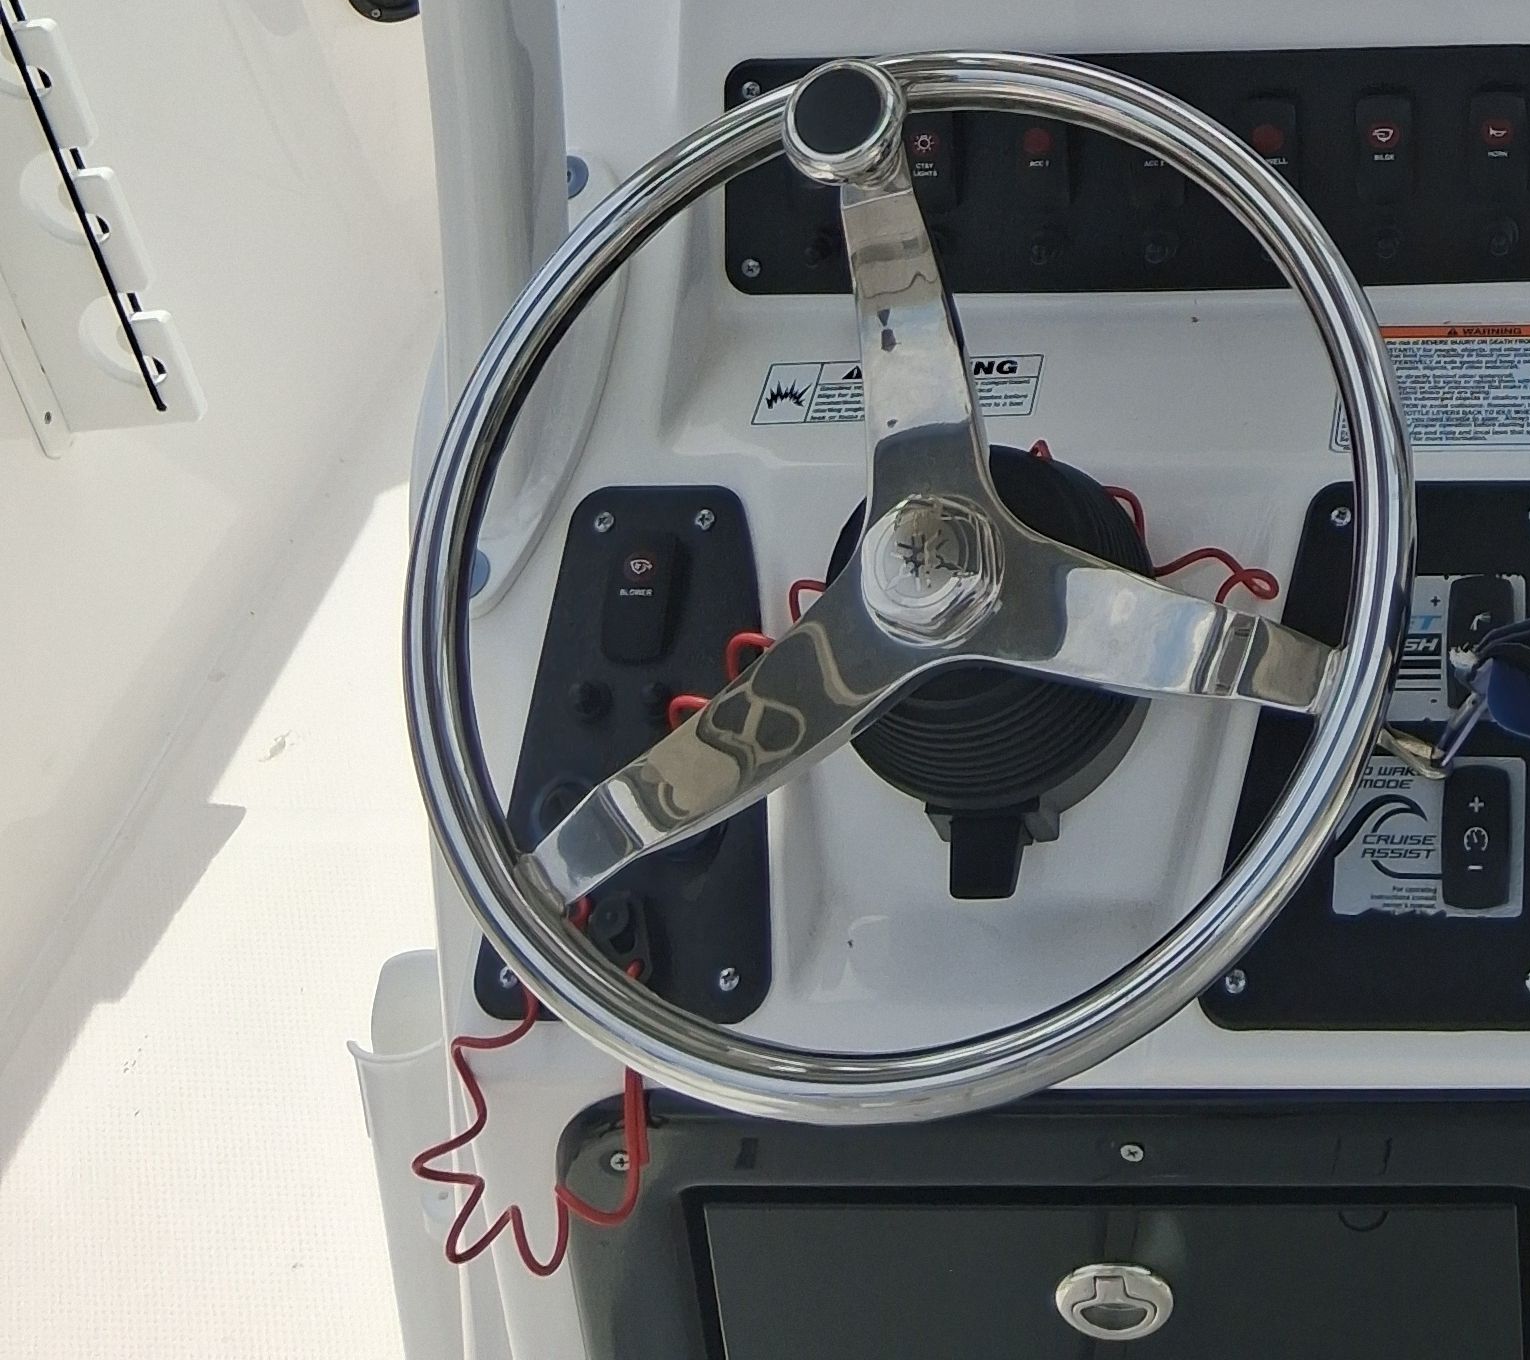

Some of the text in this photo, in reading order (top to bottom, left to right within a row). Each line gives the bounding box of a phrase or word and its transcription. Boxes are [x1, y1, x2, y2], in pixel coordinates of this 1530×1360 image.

[1378, 766, 1418, 776] WAK
[1360, 778, 1414, 789] MODE
[1361, 833, 1438, 846] CRUISE
[1360, 847, 1437, 860] ASSIST
